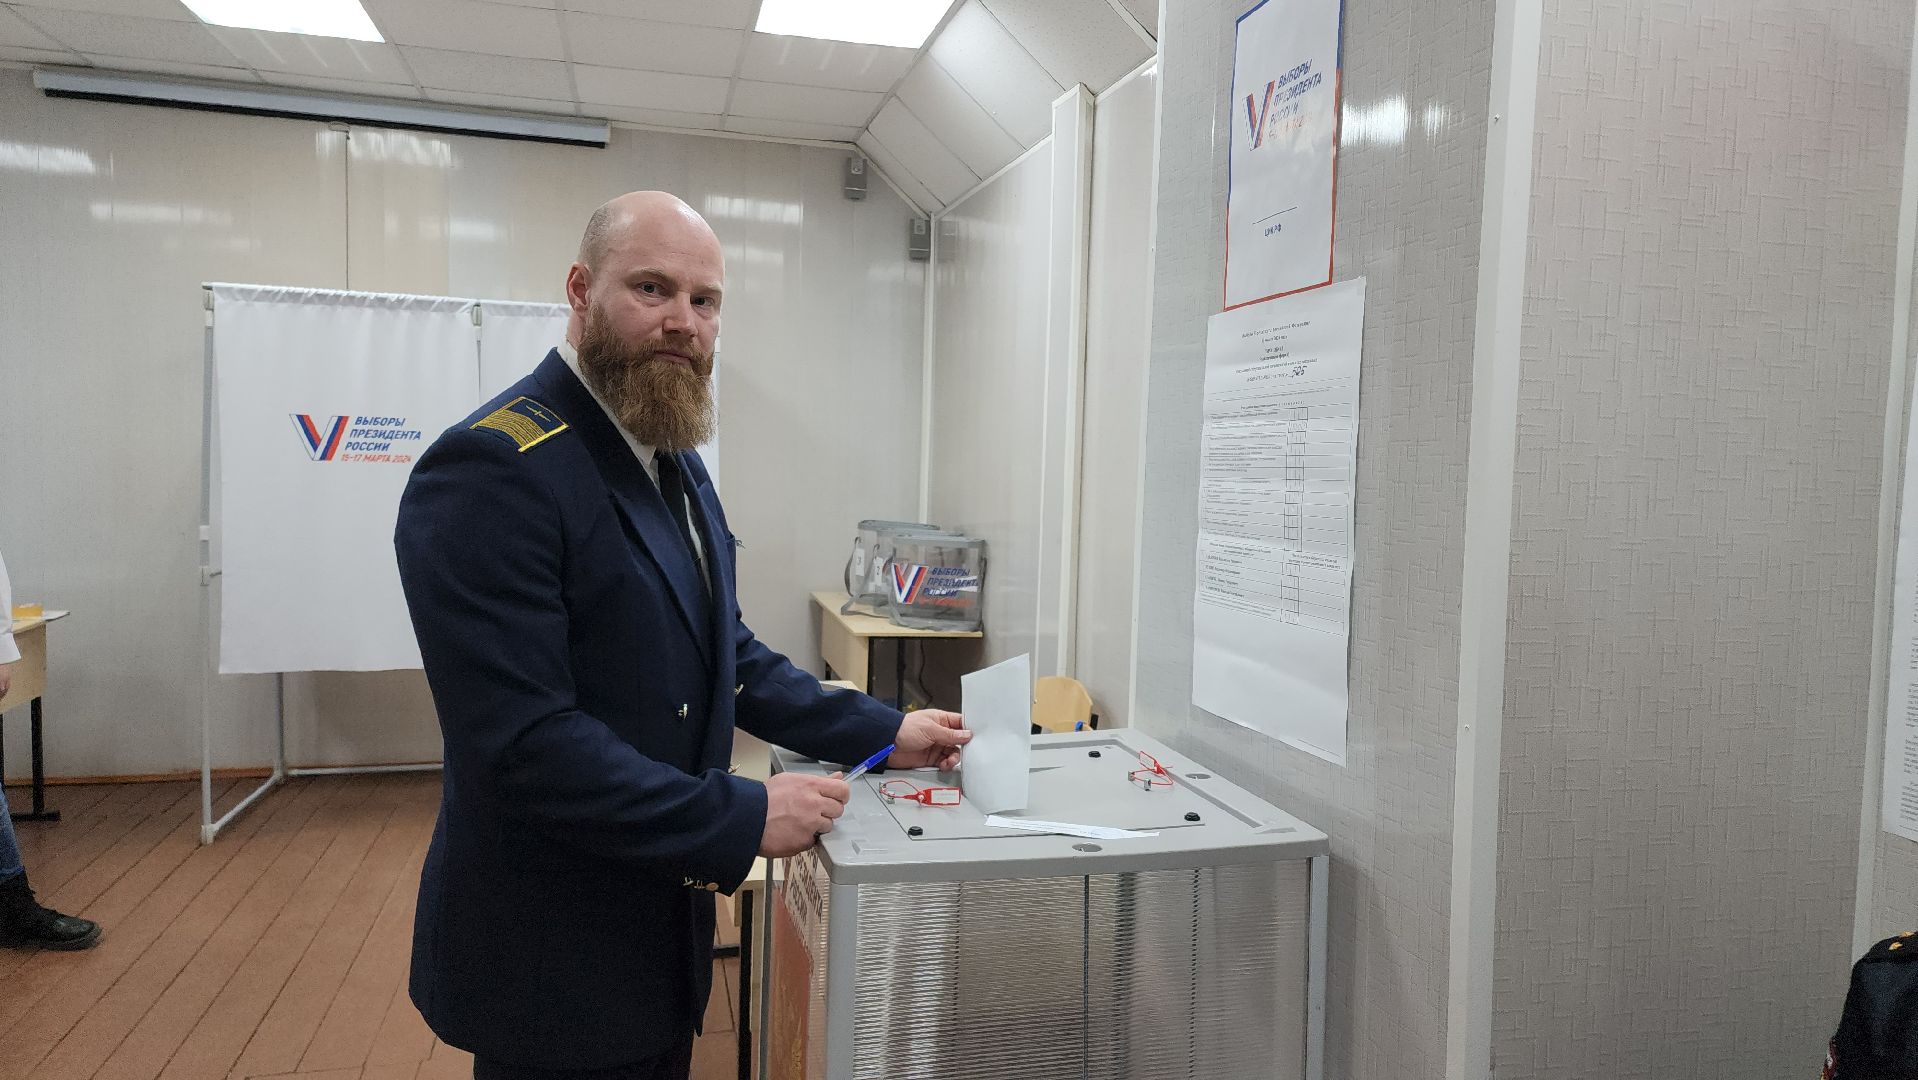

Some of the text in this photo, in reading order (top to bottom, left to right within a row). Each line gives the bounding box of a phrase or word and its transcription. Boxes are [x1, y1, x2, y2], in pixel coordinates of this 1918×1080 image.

[1277, 58, 1313, 89] ВЫБОРЫ
[1273, 72, 1322, 107] ПРЕЗИДЕНТА
[354, 416, 406, 426] ВЫБОРЫ
[349, 429, 422, 441] ПРЕЗИДЕНТА
[345, 441, 391, 452] РОССИИ
[363, 454, 391, 463] МАРТА
[391, 454, 412, 464] 2024
[931, 567, 971, 577] ВЫБОРЫ
